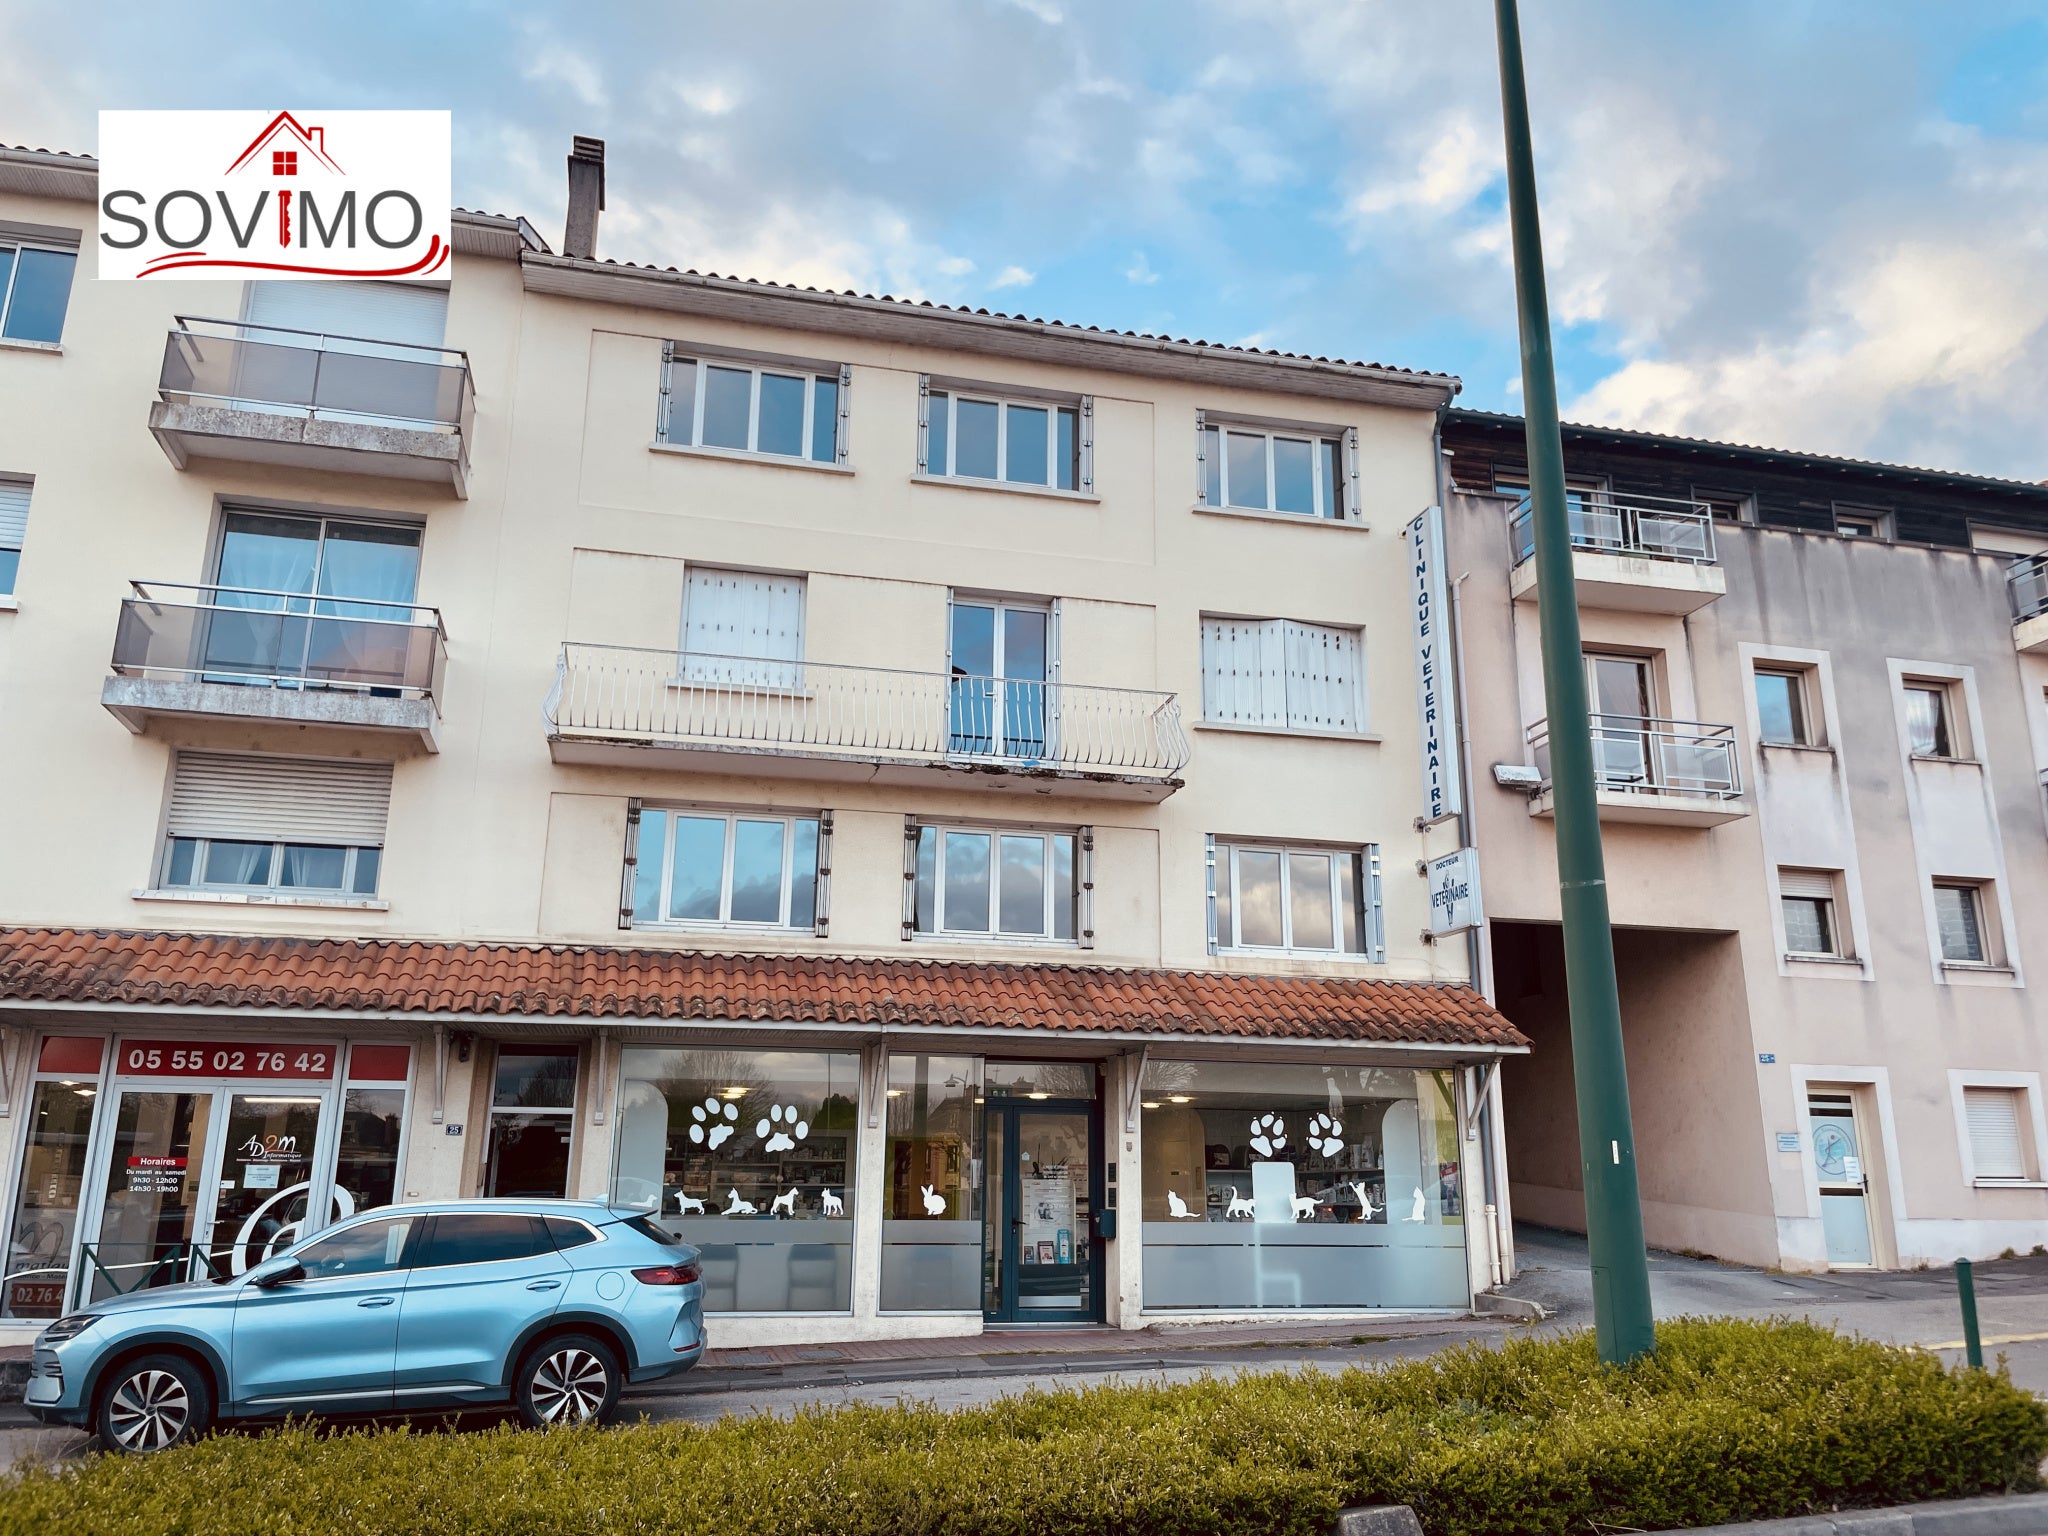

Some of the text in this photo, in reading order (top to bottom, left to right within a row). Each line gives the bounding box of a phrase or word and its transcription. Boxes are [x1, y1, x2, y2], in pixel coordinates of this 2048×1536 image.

[1414, 517, 1442, 818] CLINIQUE VETERINAIRE
[1435, 856, 1459, 870] DOCTEUR
[1431, 882, 1469, 908] VETERINAIRE
[128, 1049, 326, 1072] 05 55 02 76 42
[449, 1126, 459, 1134] 25
[140, 1157, 176, 1166] Horaires
[263, 1150, 302, 1159] Informatique
[156, 1185, 179, 1193] 19h00
[16, 1288, 33, 1303] 02
[36, 1288, 53, 1302] 76
